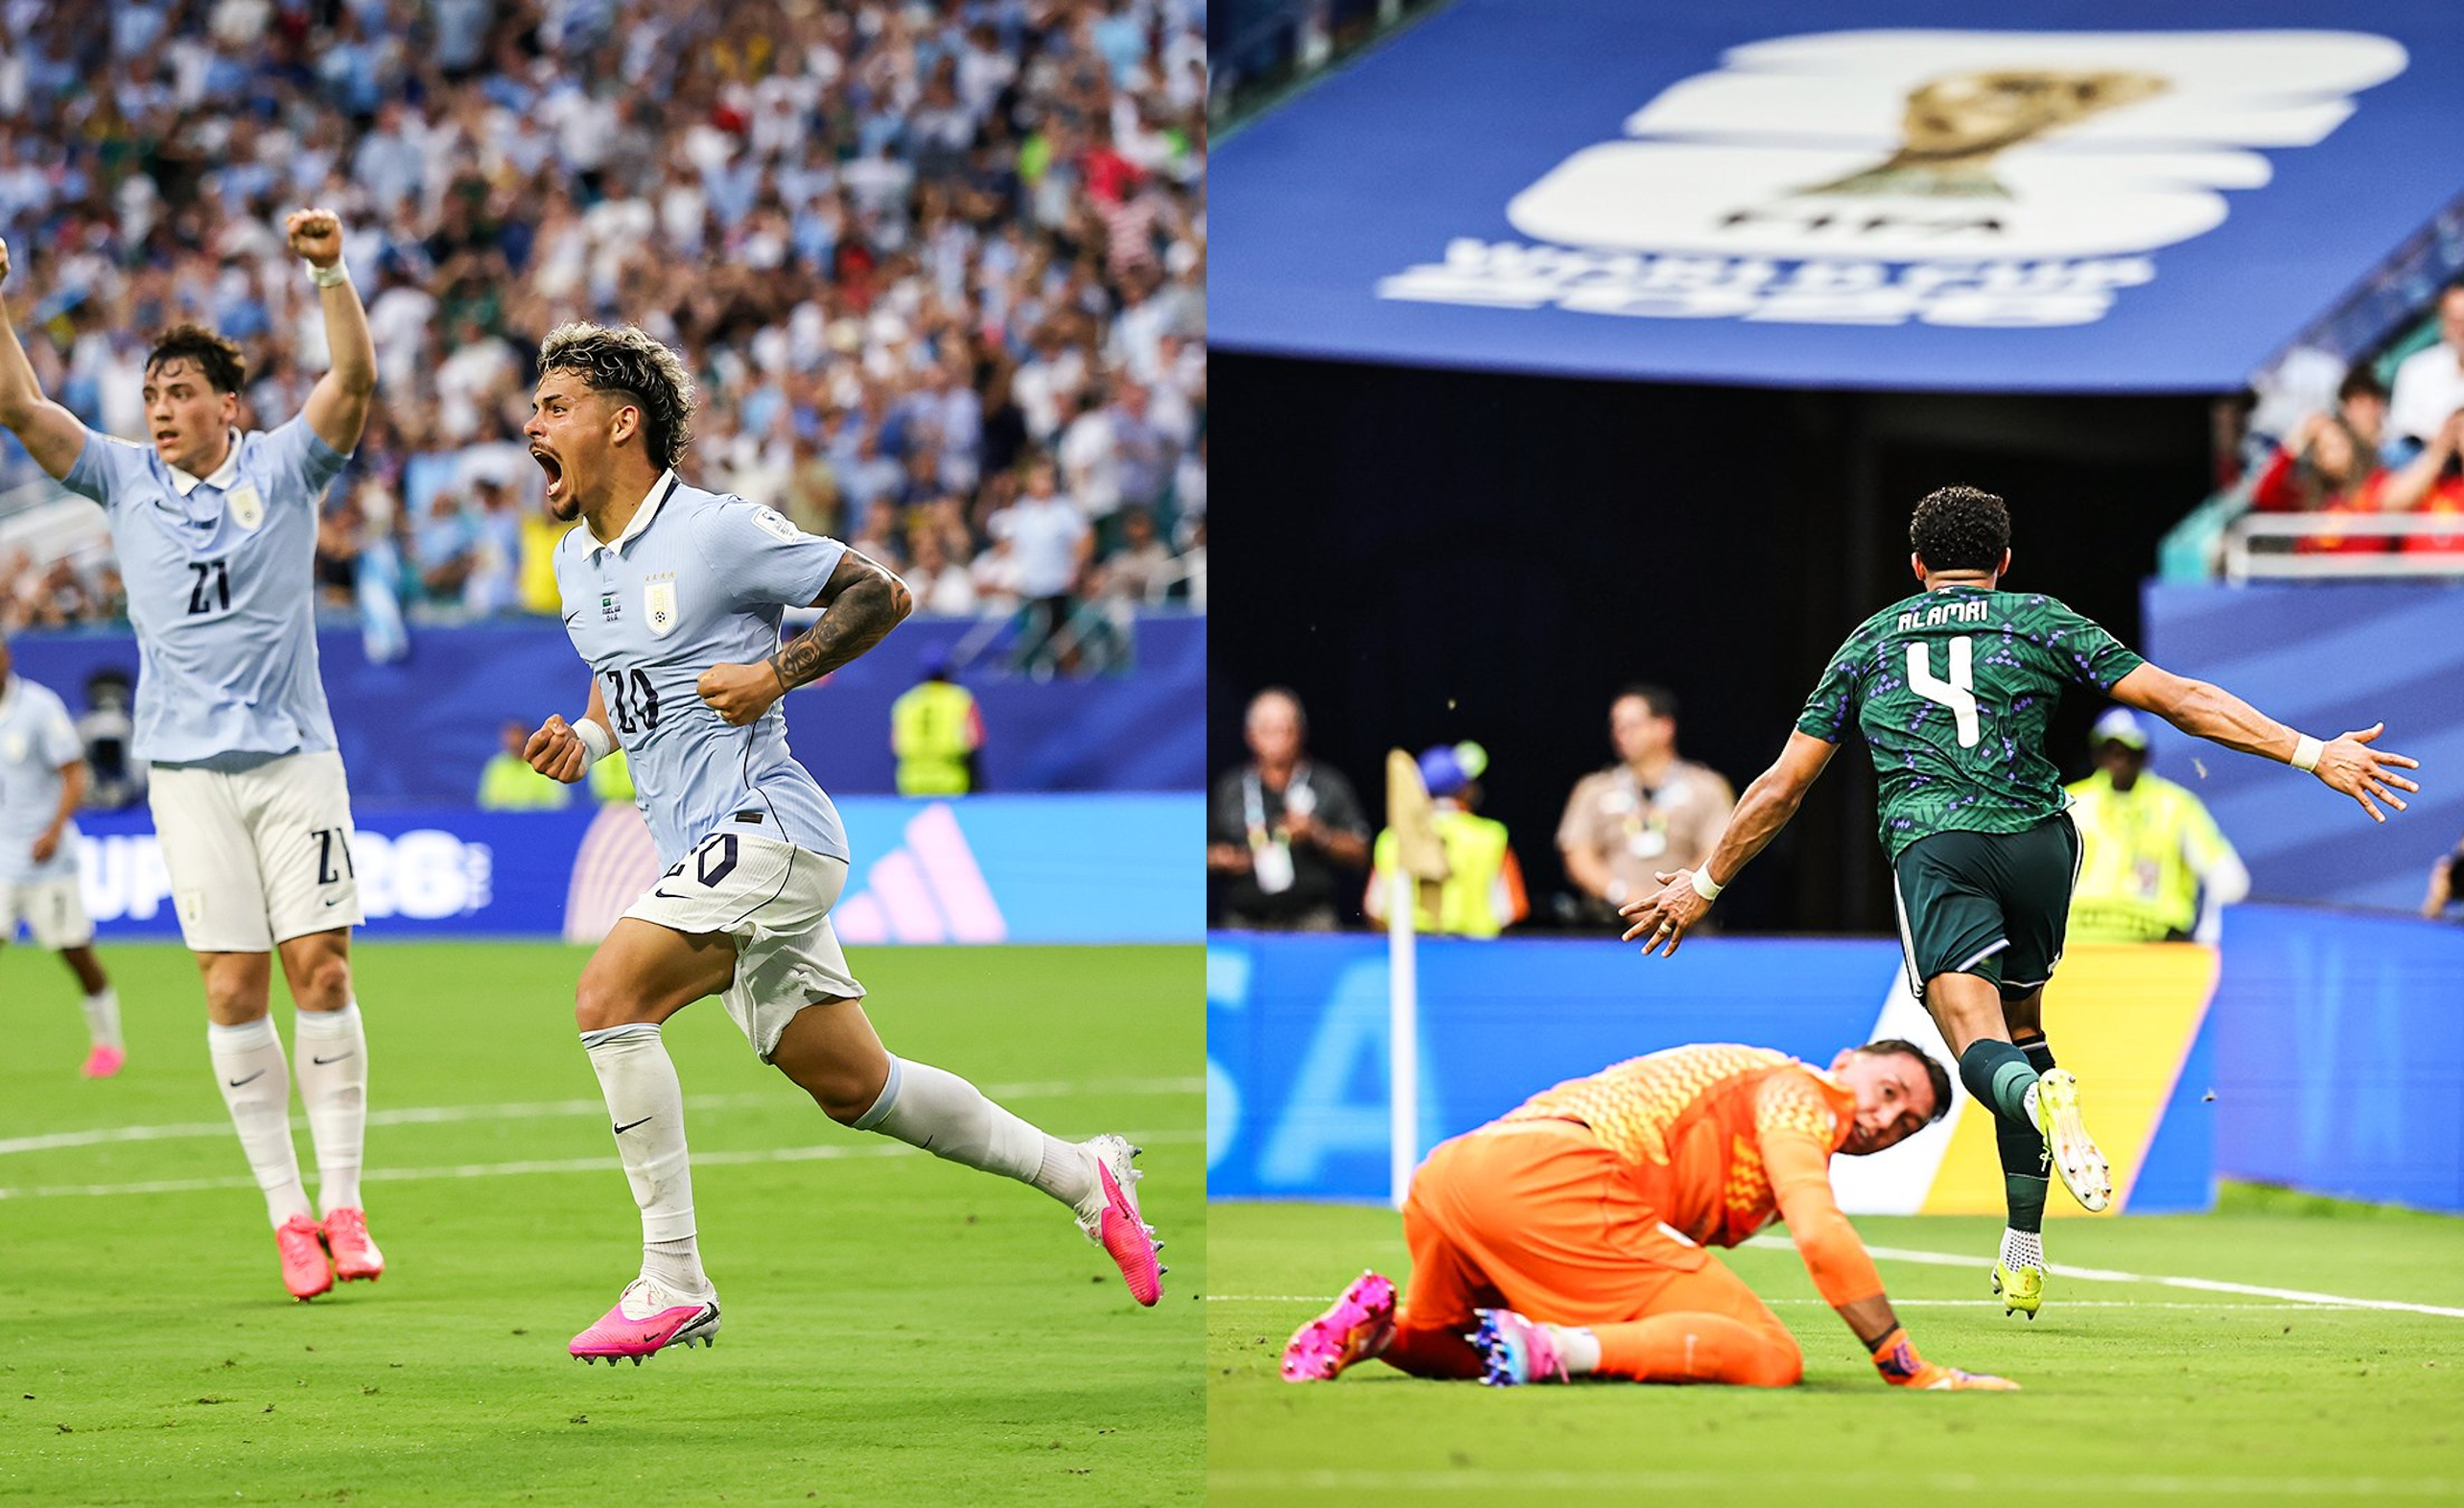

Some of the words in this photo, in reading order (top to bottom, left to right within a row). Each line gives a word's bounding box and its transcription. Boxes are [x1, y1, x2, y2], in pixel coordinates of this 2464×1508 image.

[188, 558, 230, 615] 21
[1897, 600, 1988, 633] ALAMRI
[607, 669, 659, 734] 20
[1906, 636, 1980, 749] 4
